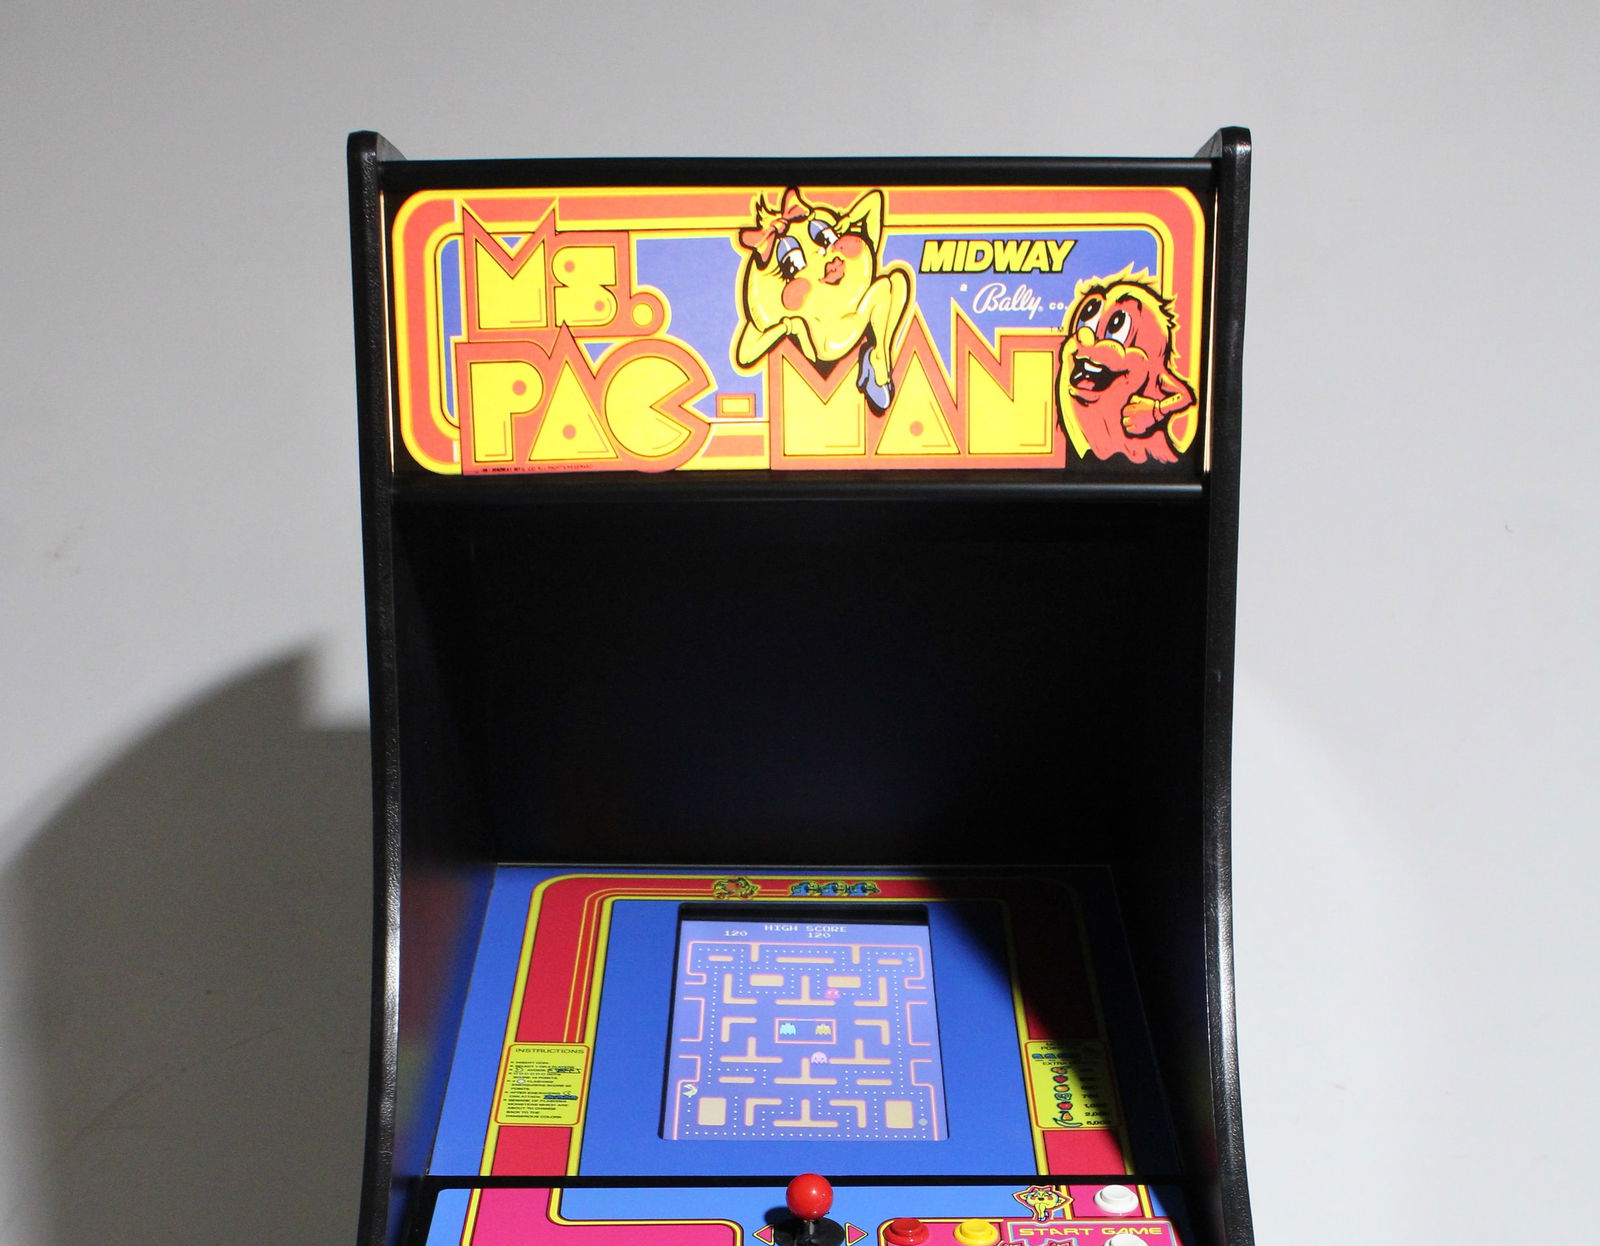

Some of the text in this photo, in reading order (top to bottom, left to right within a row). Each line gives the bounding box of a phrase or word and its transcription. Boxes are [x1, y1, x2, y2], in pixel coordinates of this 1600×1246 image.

[919, 240, 1078, 274] MIDWAY
[455, 312, 1066, 475] PAC-MAN
[764, 924, 847, 933] HIGH SCORE
[1019, 1227, 1163, 1236] START GAME
